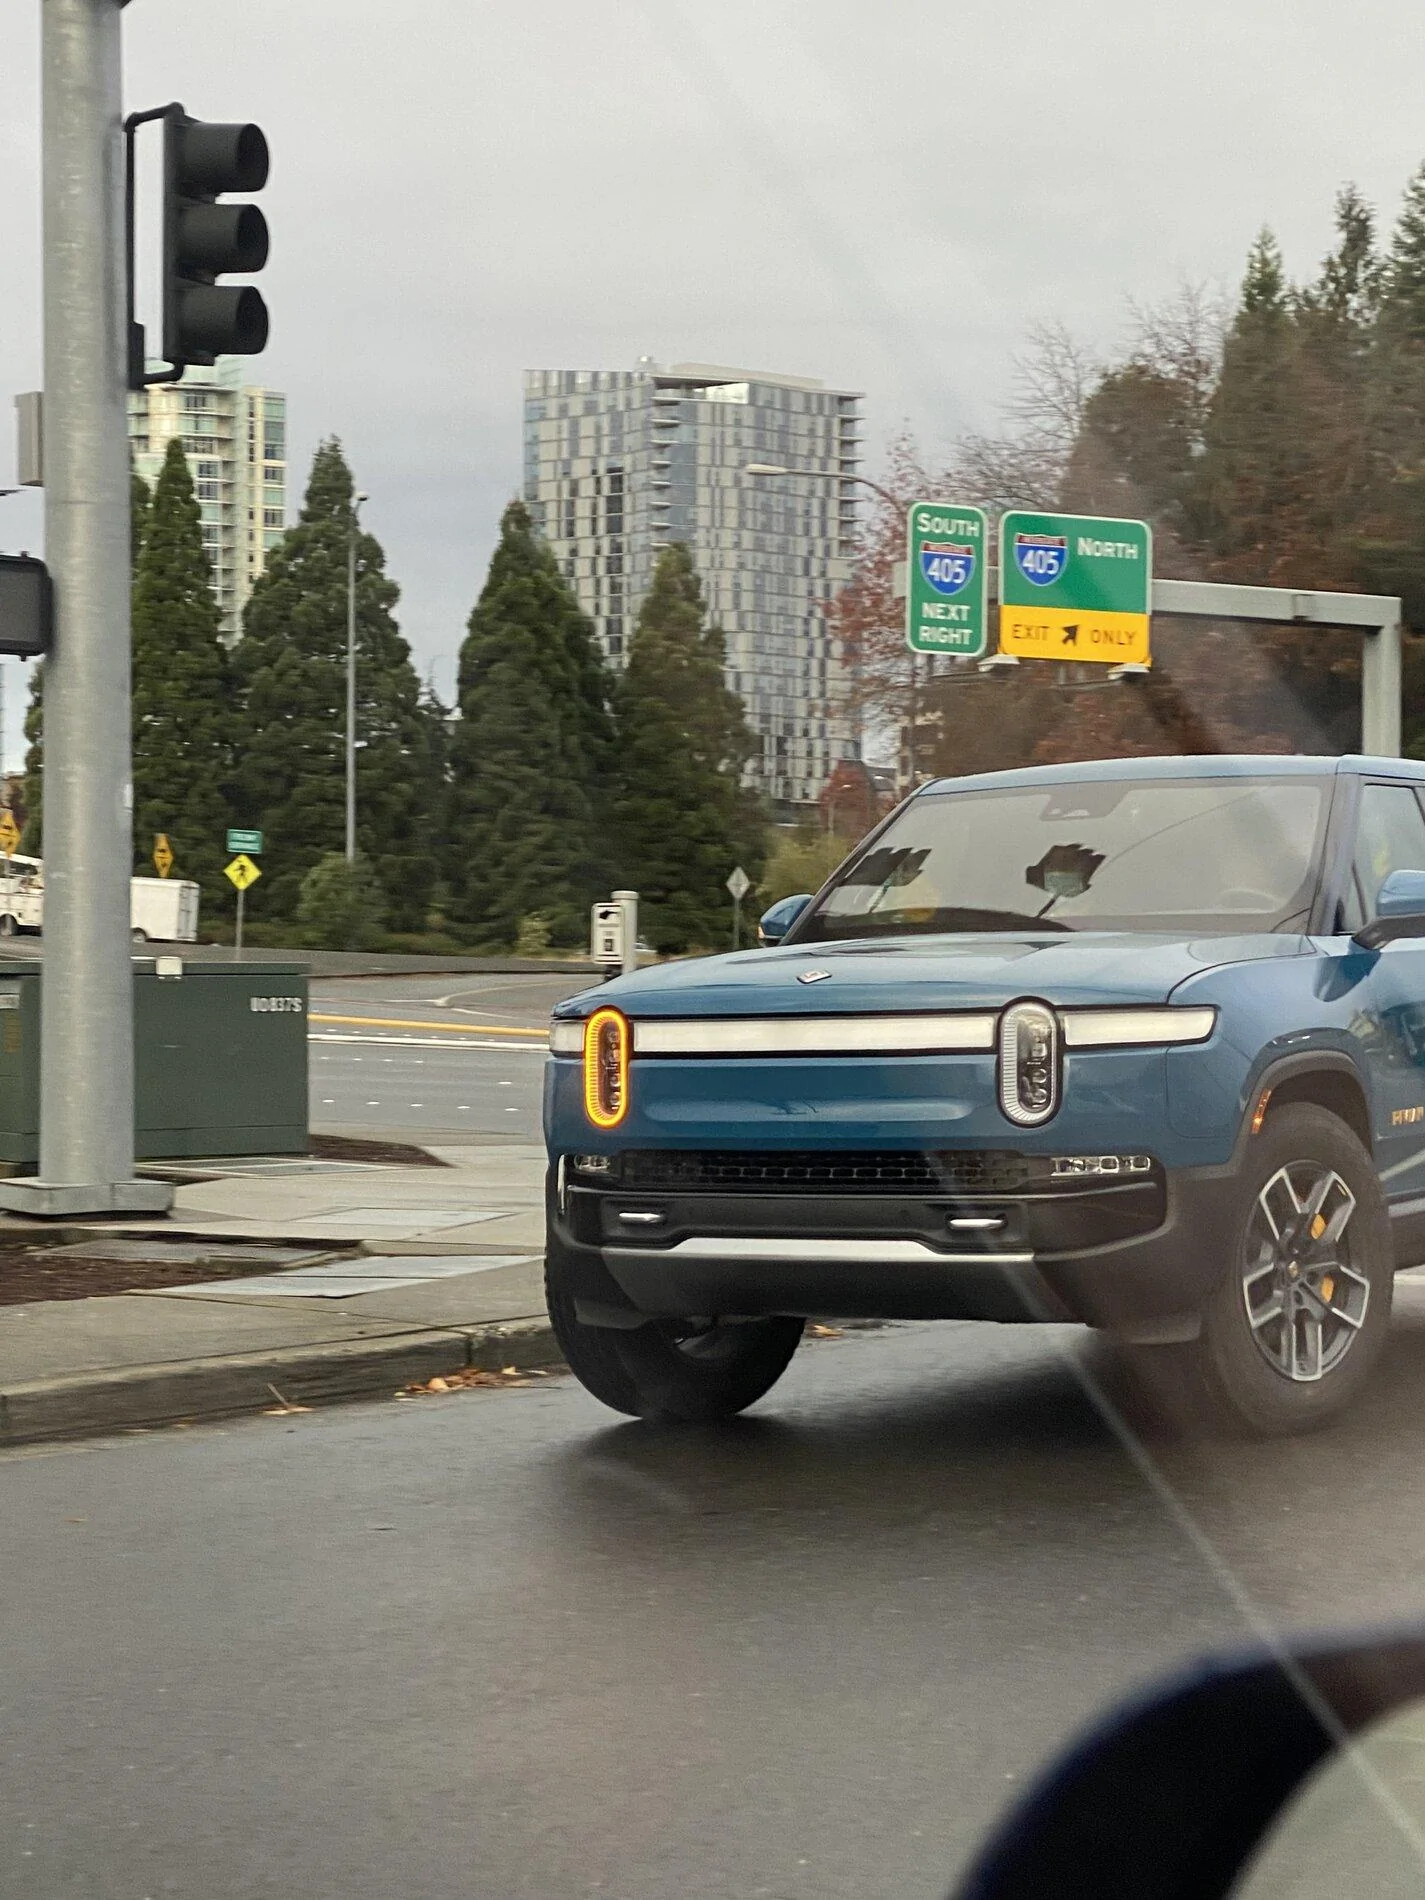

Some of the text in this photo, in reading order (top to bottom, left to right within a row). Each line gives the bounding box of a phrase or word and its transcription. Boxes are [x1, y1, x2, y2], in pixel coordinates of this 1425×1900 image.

[917, 512, 980, 537] SOUTH
[1022, 549, 1060, 574] 405
[1077, 536, 1139, 559] NORTH
[927, 557, 966, 583] 405
[922, 602, 971, 621] NEXT
[919, 625, 973, 645] RIGHT
[1012, 624, 1136, 645] EXIT ONLY
